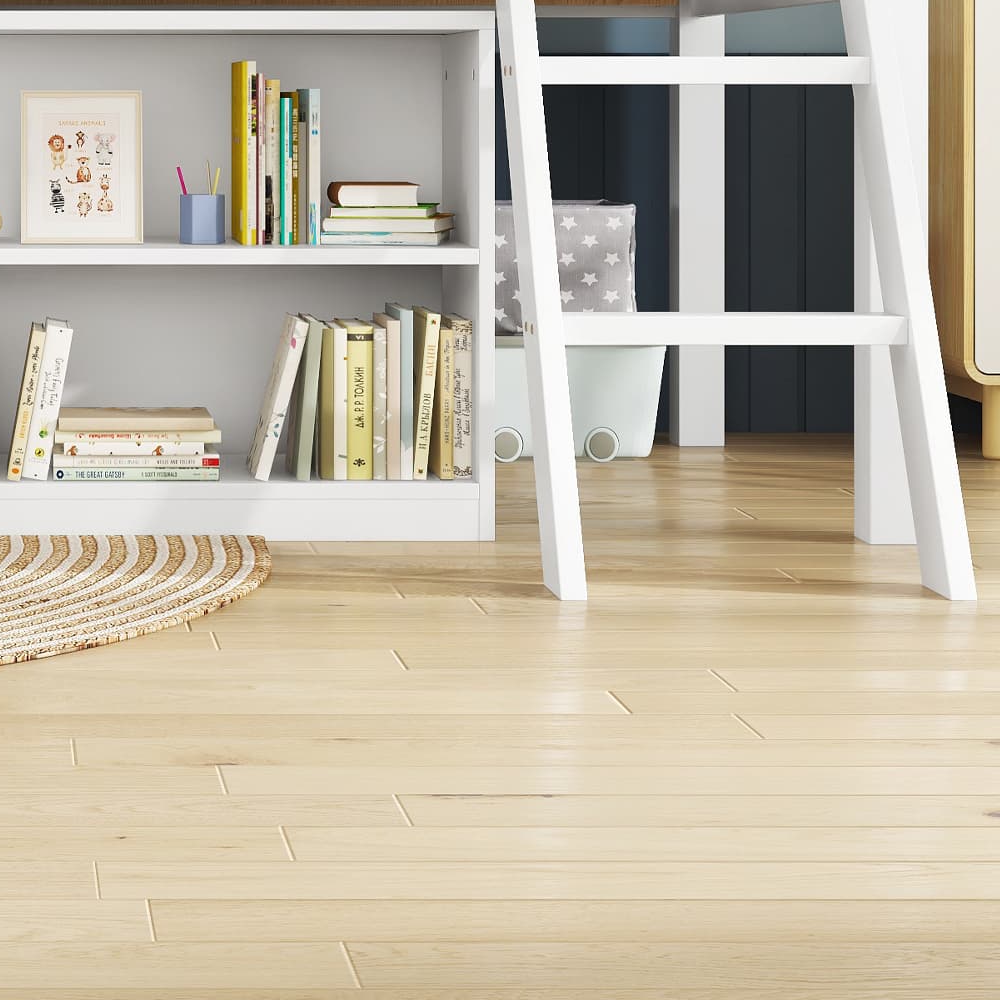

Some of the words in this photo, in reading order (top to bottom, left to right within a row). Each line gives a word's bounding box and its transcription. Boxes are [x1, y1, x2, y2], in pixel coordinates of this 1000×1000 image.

[354, 367, 364, 398] ТОЛКИН
[420, 393, 431, 432] КРЫЛОВ
[75, 471, 86, 479] THE
[87, 471, 104, 479] GREAT
[105, 471, 125, 479] GATSBY
